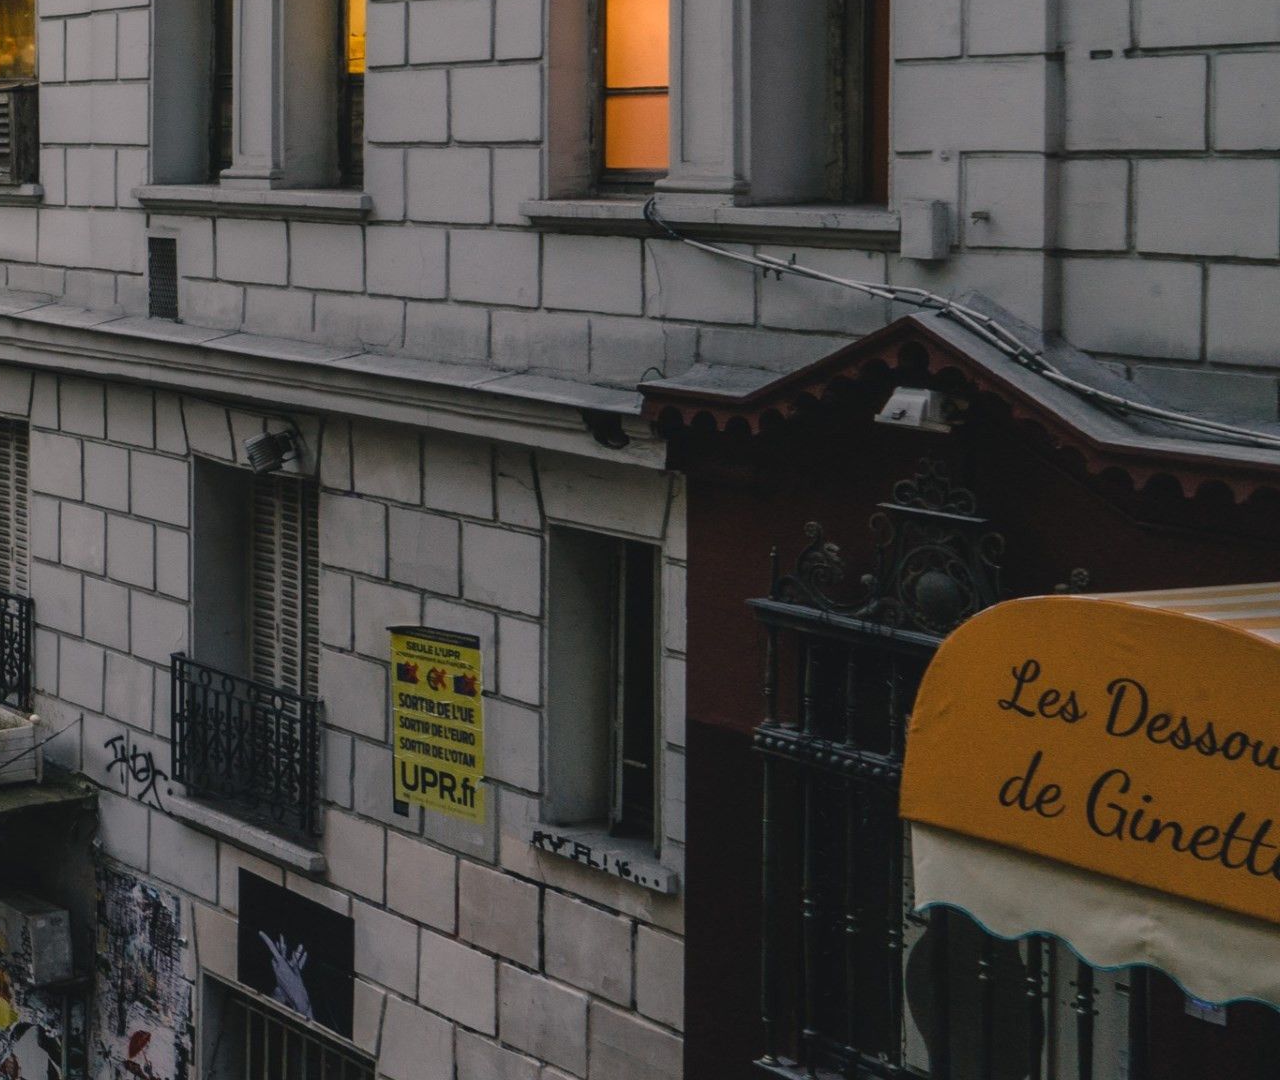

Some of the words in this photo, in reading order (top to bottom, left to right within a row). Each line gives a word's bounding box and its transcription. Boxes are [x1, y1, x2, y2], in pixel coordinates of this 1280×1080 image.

[406, 641, 433, 655] SEULE
[998, 659, 1088, 724] Les
[399, 692, 435, 711] SORTIR
[437, 701, 450, 717] DE
[452, 705, 474, 724] L'UE
[399, 716, 431, 732] SORTIR
[432, 723, 443, 738] DE
[444, 726, 475, 746] L'EURO
[400, 737, 431, 754] SORTIR
[432, 744, 443, 759] DE
[445, 748, 475, 768] L'OTAN
[401, 761, 475, 808] UPR.fr
[999, 749, 1065, 818] de
[1085, 768, 1280, 882] Ginett
